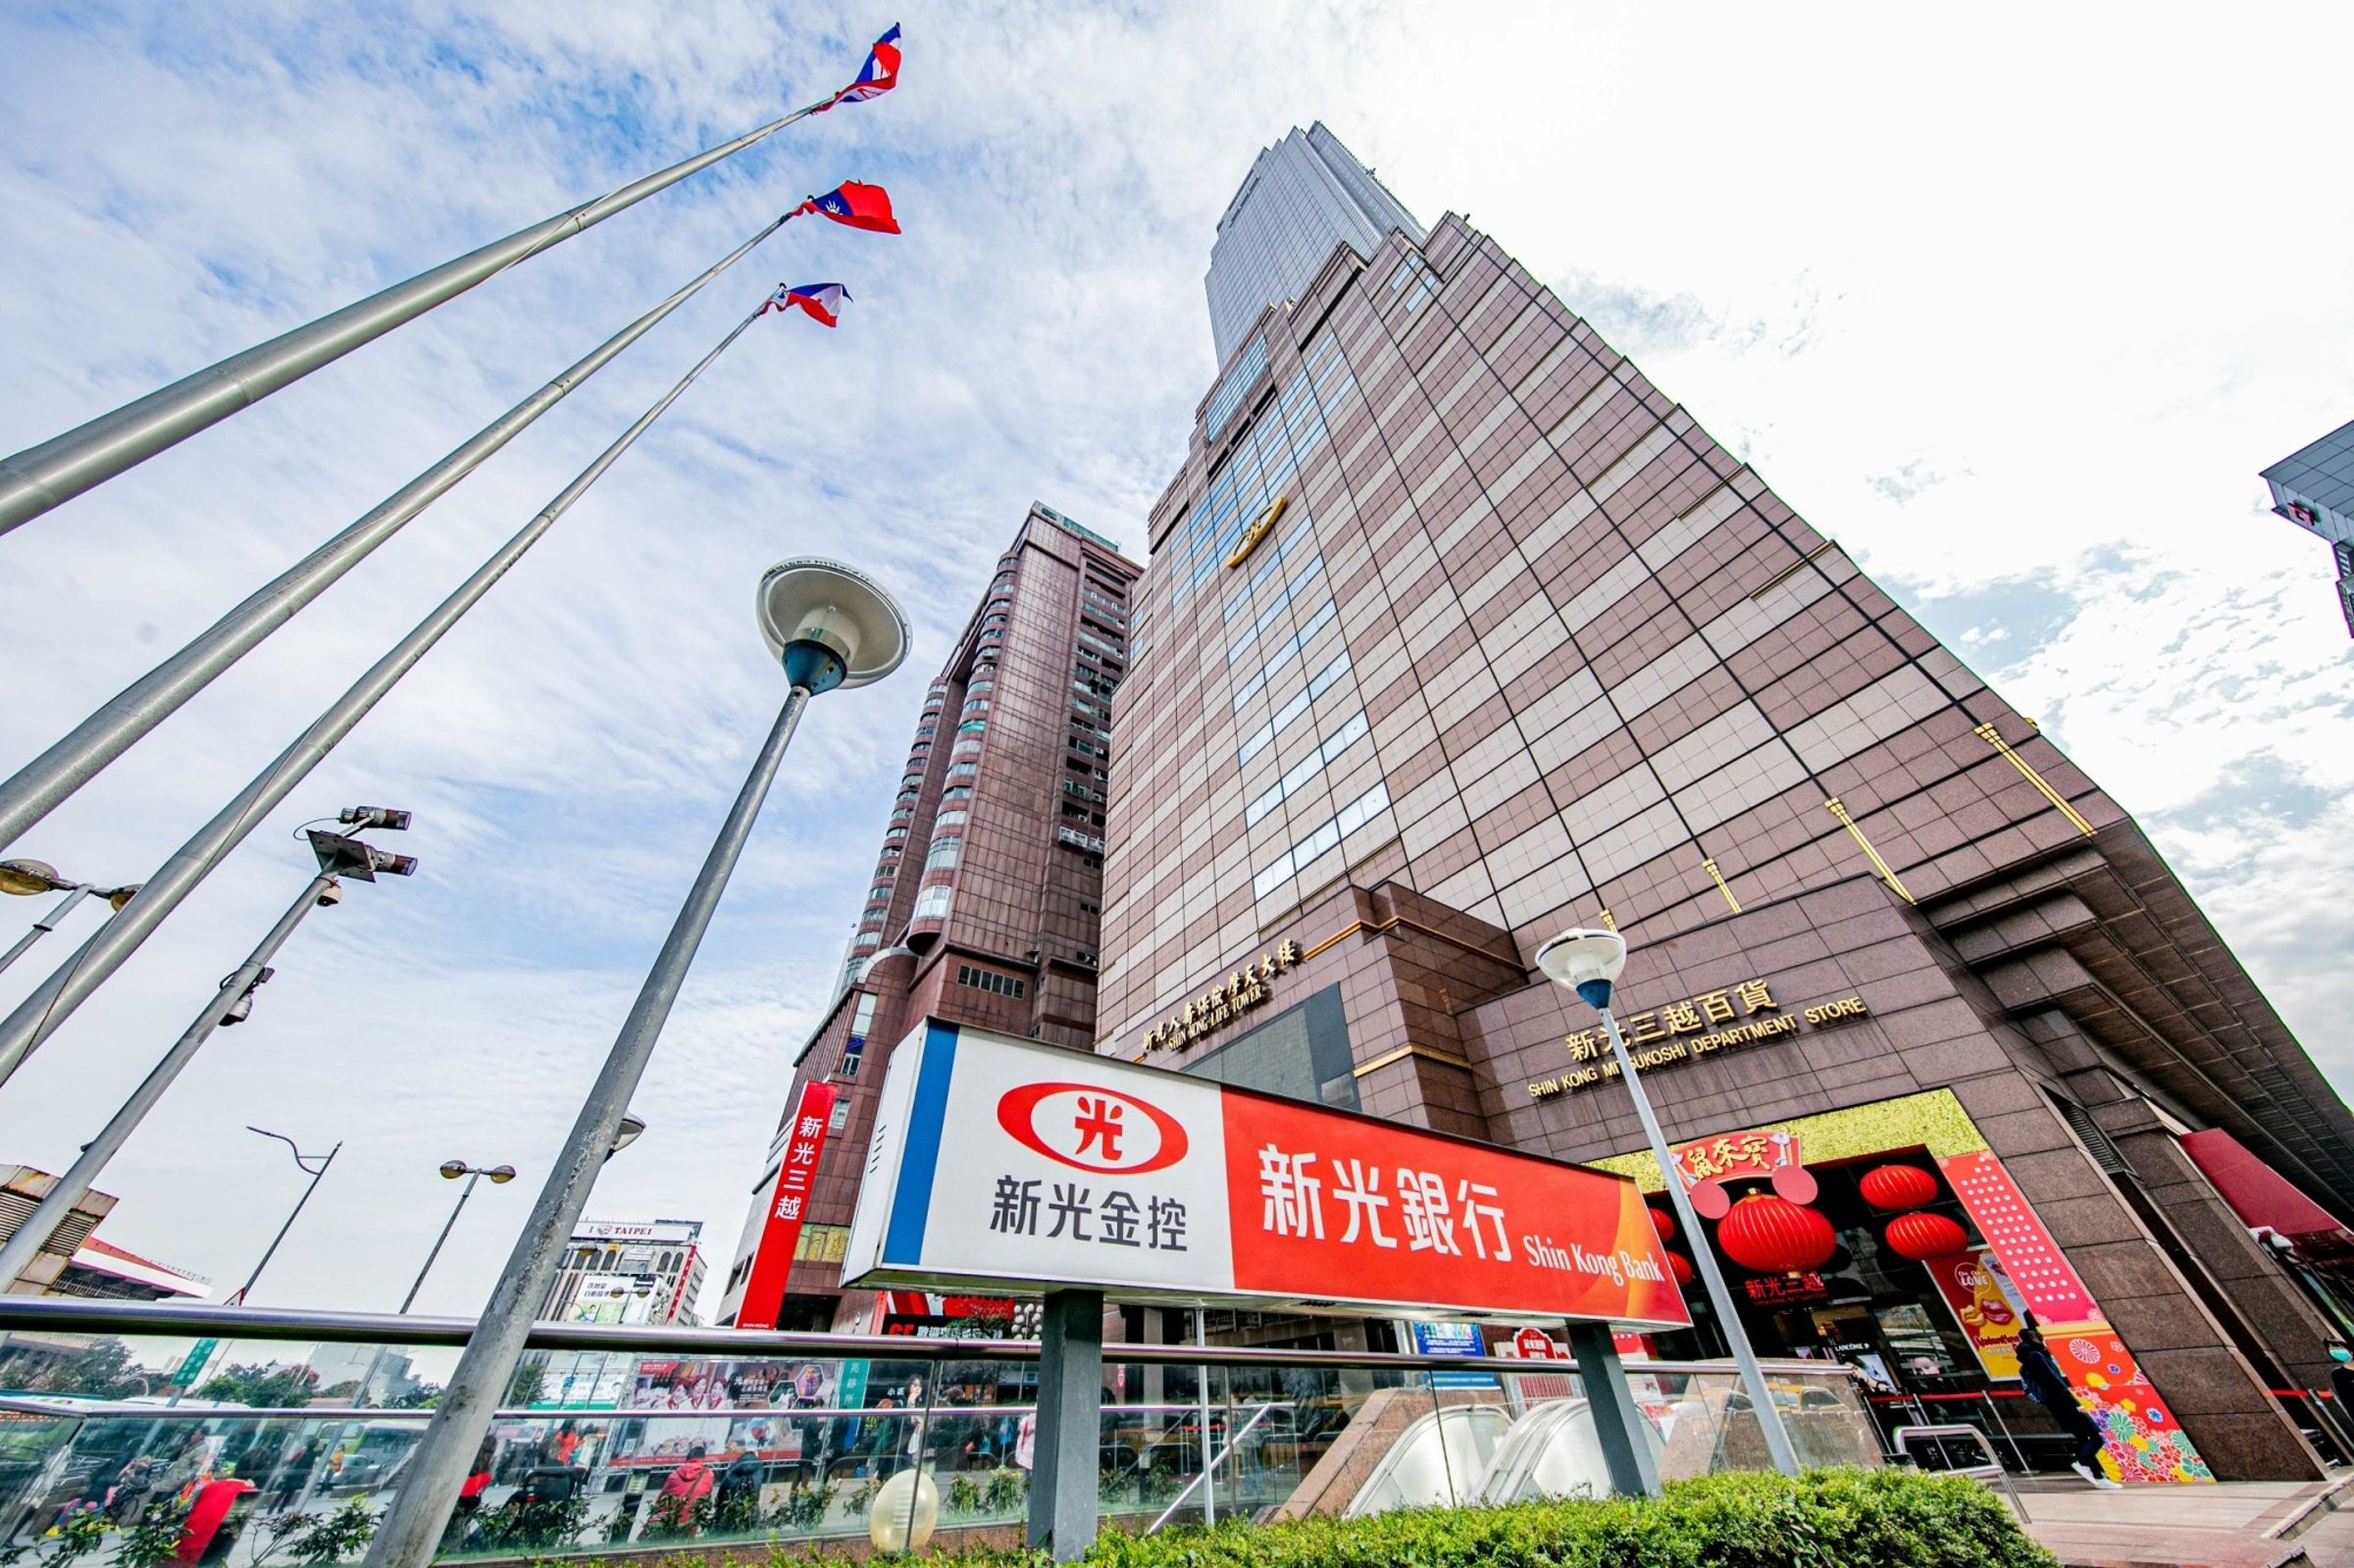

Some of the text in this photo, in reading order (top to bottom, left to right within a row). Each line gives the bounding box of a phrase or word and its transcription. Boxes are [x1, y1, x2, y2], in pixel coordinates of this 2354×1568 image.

[1168, 985, 1262, 1050] SHIN KONG LIFE TOWER
[1528, 995, 1867, 1098] SHIN KONG MISUKOSHI DEPARTMENT STORE
[1564, 979, 1778, 1062] 新光三越百貨
[1074, 1096, 1123, 1161] 光
[774, 1115, 824, 1221] 新光三越
[1257, 1142, 1511, 1262] 新光銀行
[614, 1227, 653, 1236] TAIPEI
[989, 1174, 1188, 1252] 新光金控
[1522, 1235, 1665, 1287] Shin Kong Bank
[1744, 1271, 1825, 1299] 新光三越
